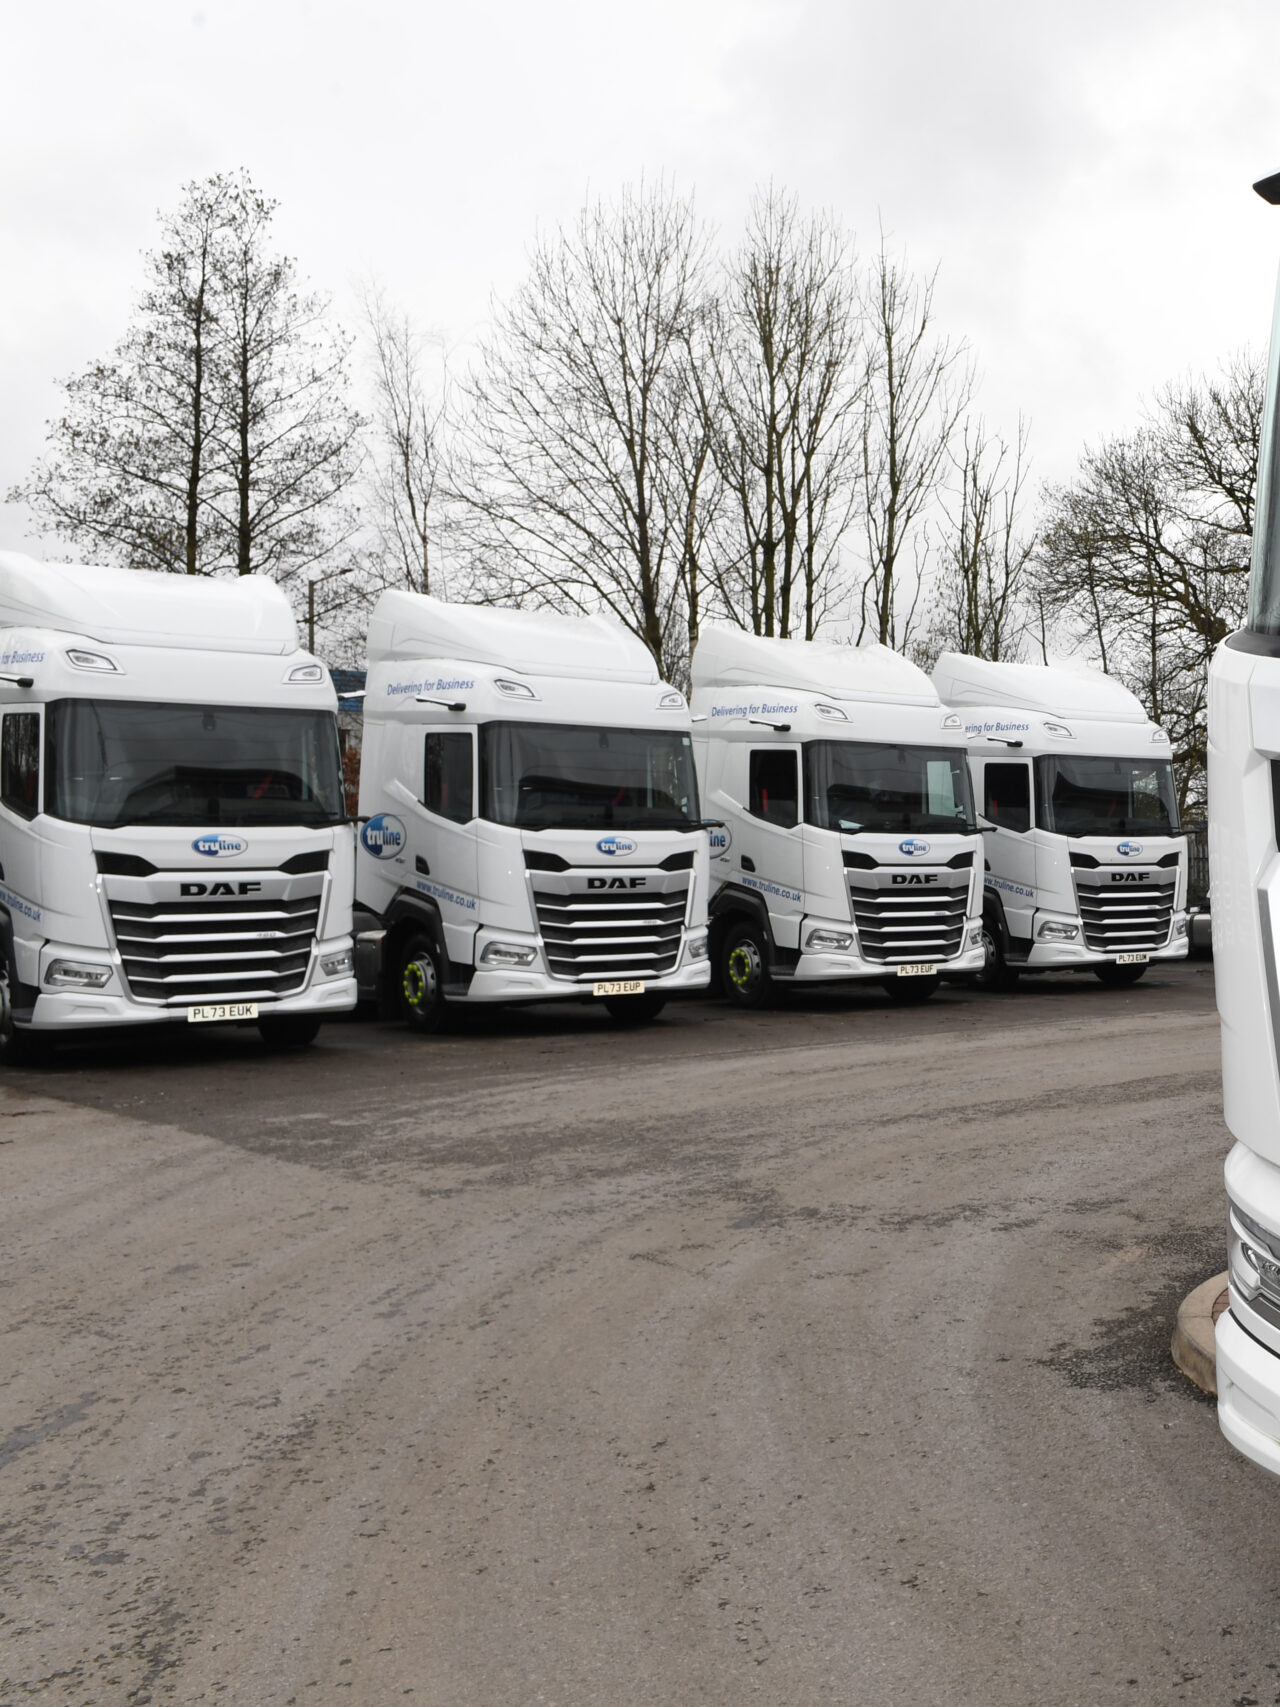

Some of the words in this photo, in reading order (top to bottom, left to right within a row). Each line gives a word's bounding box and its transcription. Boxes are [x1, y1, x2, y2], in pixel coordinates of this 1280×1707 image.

[387, 682, 422, 695] Delivering
[424, 680, 435, 691] for
[436, 679, 475, 690] Business
[711, 704, 748, 717] Delivering
[749, 704, 760, 714] for
[761, 703, 799, 714] Business
[984, 722, 995, 732] for
[995, 721, 1030, 731] Business
[366, 826, 401, 846] truline
[198, 840, 242, 851] truline
[600, 841, 633, 851] truline
[587, 877, 647, 889] DAF
[892, 874, 938, 885] DAF
[1111, 872, 1150, 882] DAF
[180, 882, 262, 896] DAF
[416, 880, 476, 910] www.truline.co.uk
[742, 876, 802, 902] www.truline.co.uk
[900, 965, 919, 975] PL73
[597, 983, 622, 993] PL73
[623, 981, 641, 992] EUP
[193, 1006, 226, 1019] PL73
[229, 1005, 253, 1017] EUK
